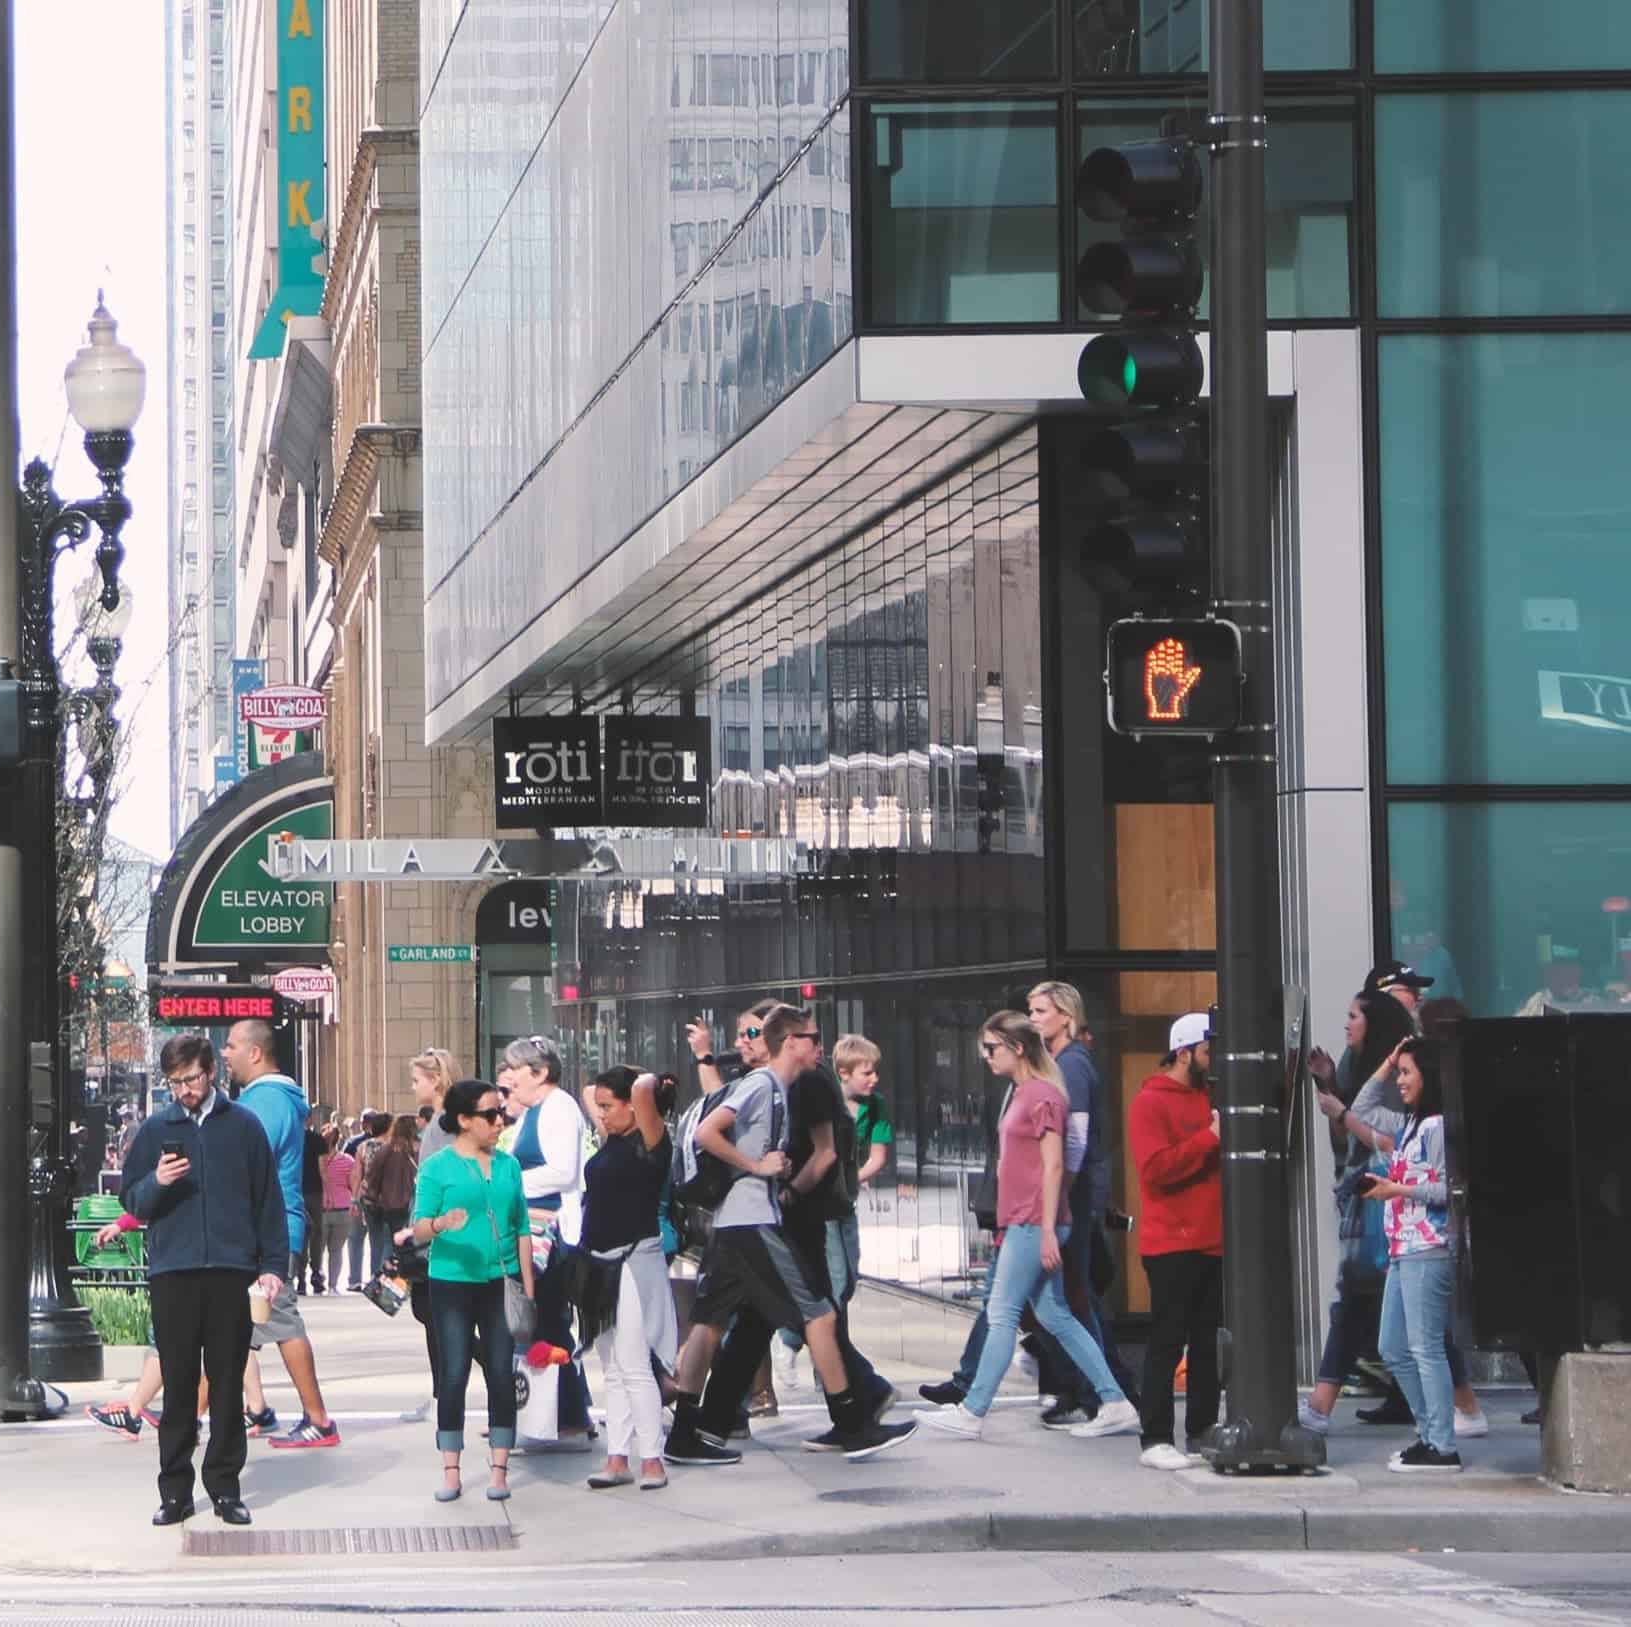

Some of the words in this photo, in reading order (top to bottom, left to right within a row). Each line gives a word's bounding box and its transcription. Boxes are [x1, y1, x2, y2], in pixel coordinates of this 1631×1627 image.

[244, 698, 280, 716] BILLY
[524, 786, 573, 796] MODERN
[220, 890, 325, 907] ELEVATOR
[240, 916, 305, 934] LOBBY
[399, 947, 456, 960] GARLAND
[159, 998, 220, 1016] ENTER
[224, 998, 272, 1016] HERE
